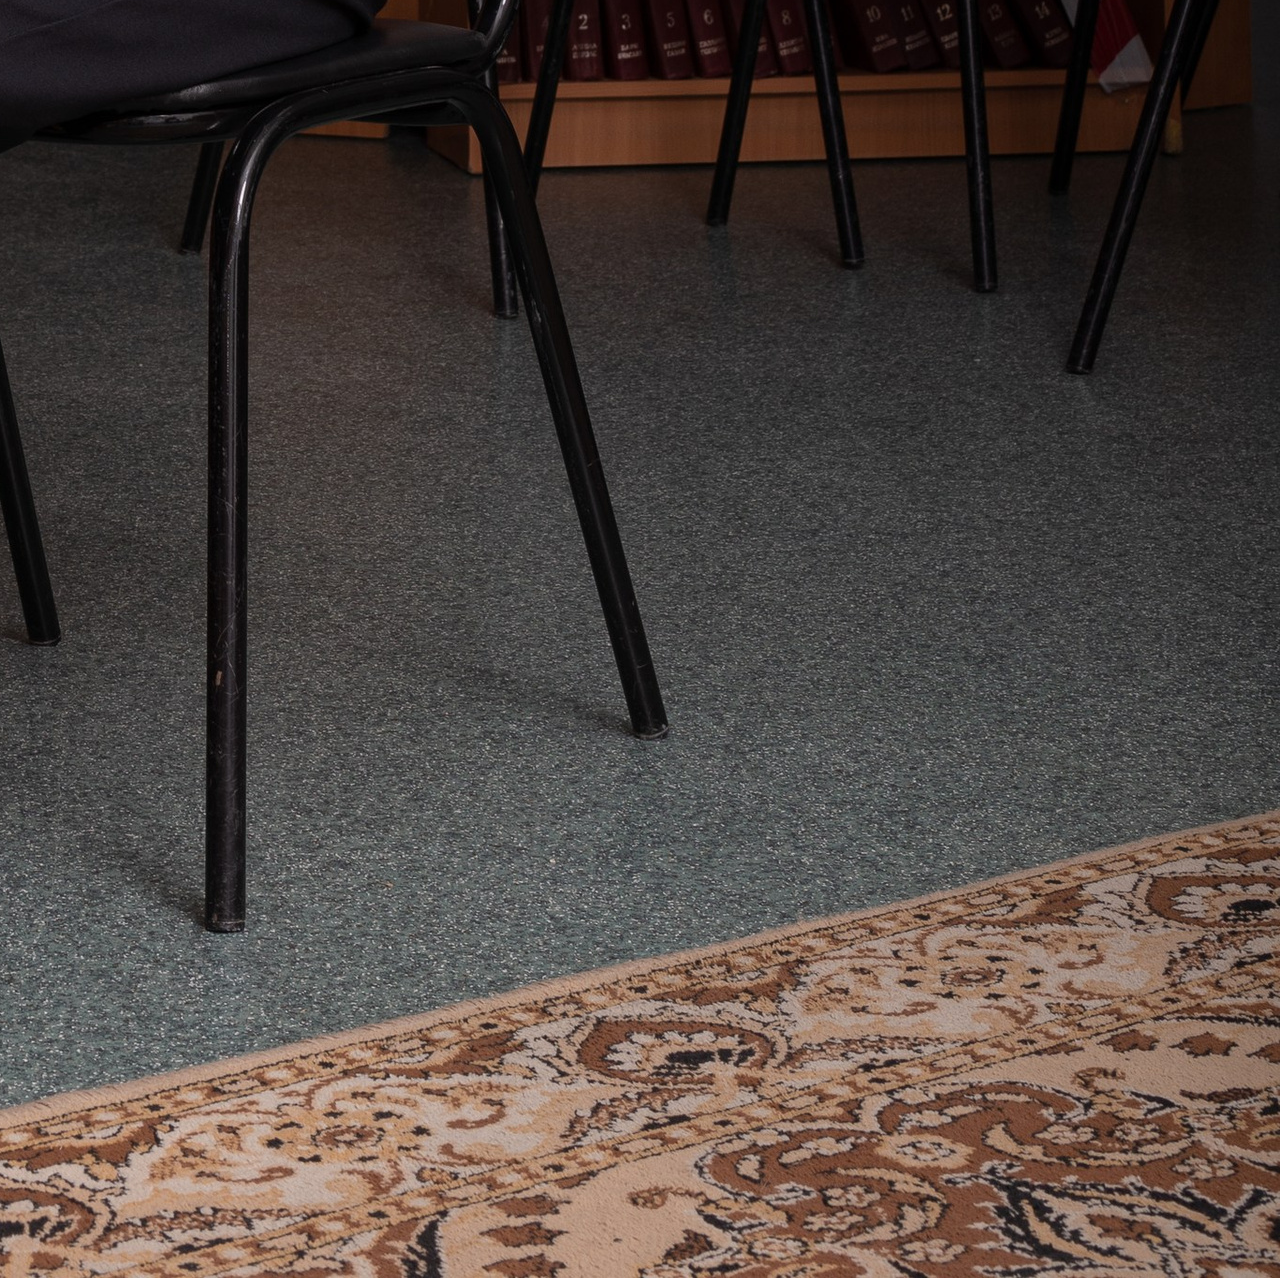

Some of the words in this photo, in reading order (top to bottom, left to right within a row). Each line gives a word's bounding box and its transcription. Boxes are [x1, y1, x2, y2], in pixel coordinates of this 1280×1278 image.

[702, 8, 714, 25] 6
[781, 8, 792, 25] 8
[866, 4, 881, 23] 10
[900, 4, 915, 22] 11
[936, 3, 954, 22] 12
[987, 3, 1003, 22] 13
[1034, 0, 1051, 20] 14
[578, 13, 589, 31] 2
[621, 13, 631, 31] 3
[666, 11, 676, 28] 5
